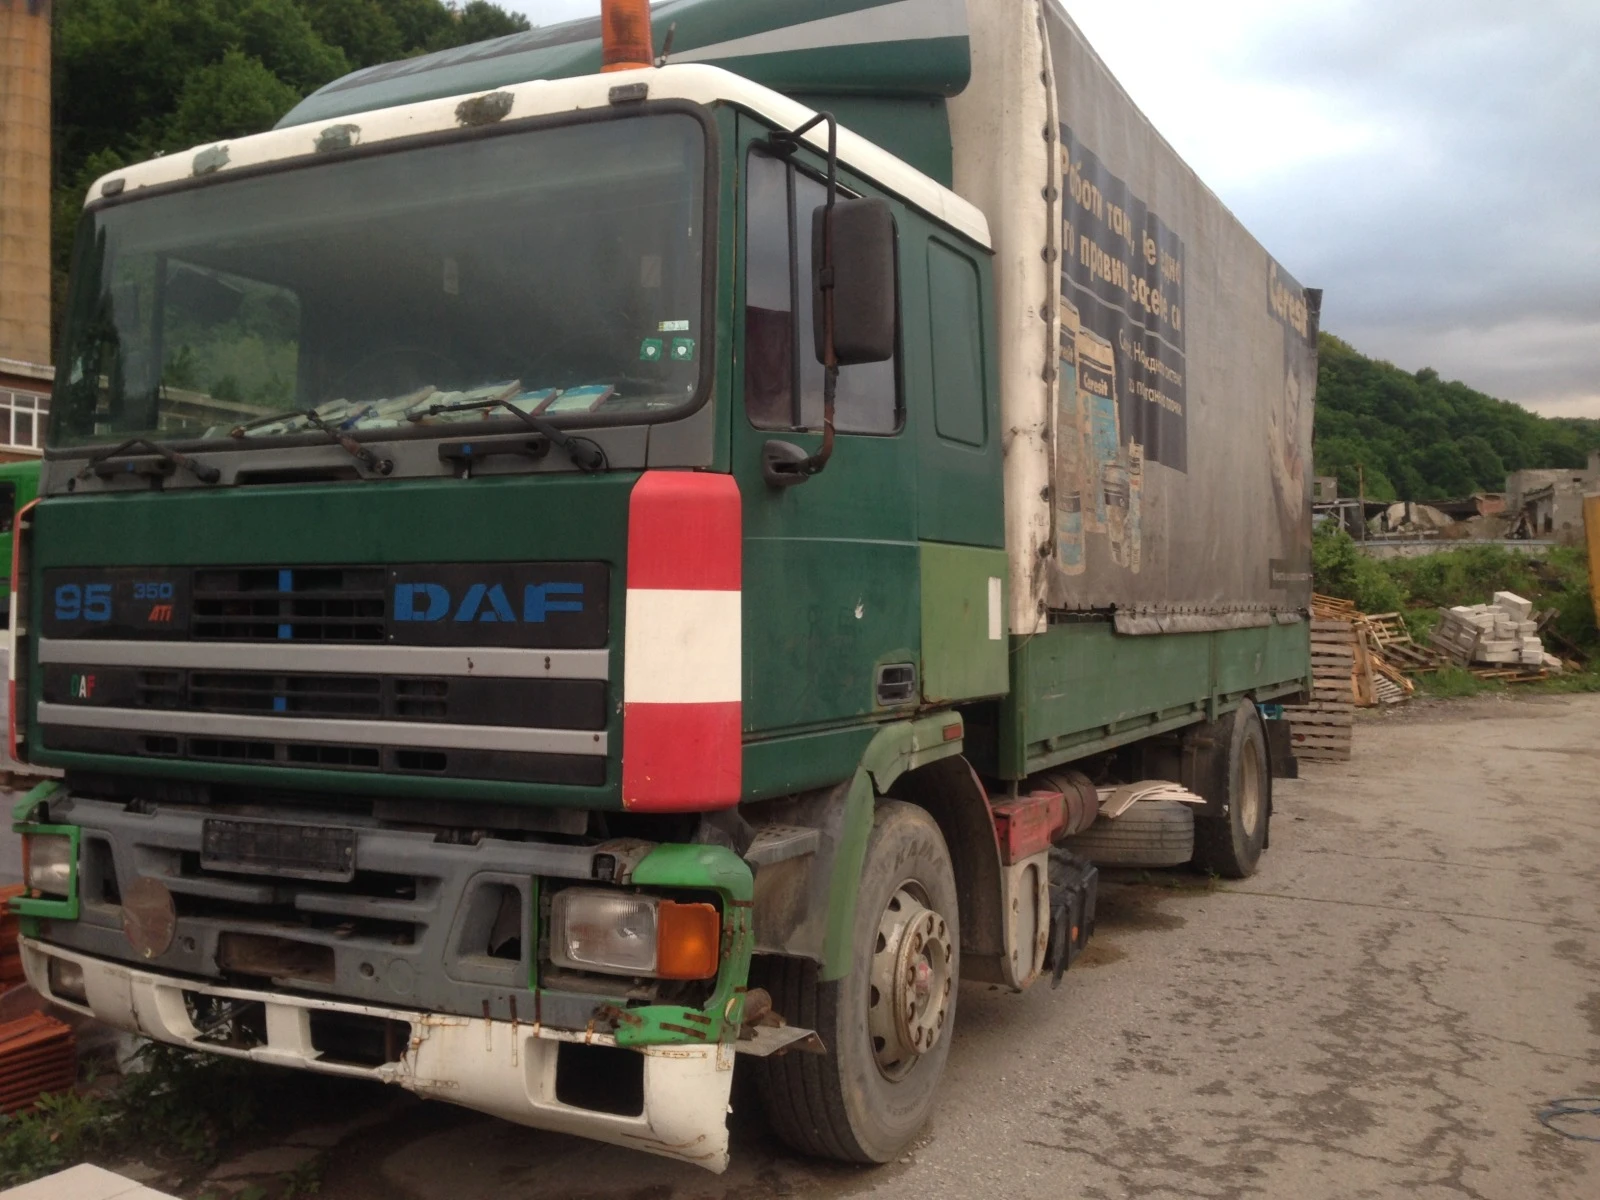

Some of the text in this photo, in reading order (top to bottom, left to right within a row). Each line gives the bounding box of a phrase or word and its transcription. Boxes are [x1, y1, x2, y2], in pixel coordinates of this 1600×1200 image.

[54, 583, 113, 622] 95
[133, 582, 174, 600] 350
[393, 582, 584, 623] DAF
[69, 673, 96, 699] DAF
